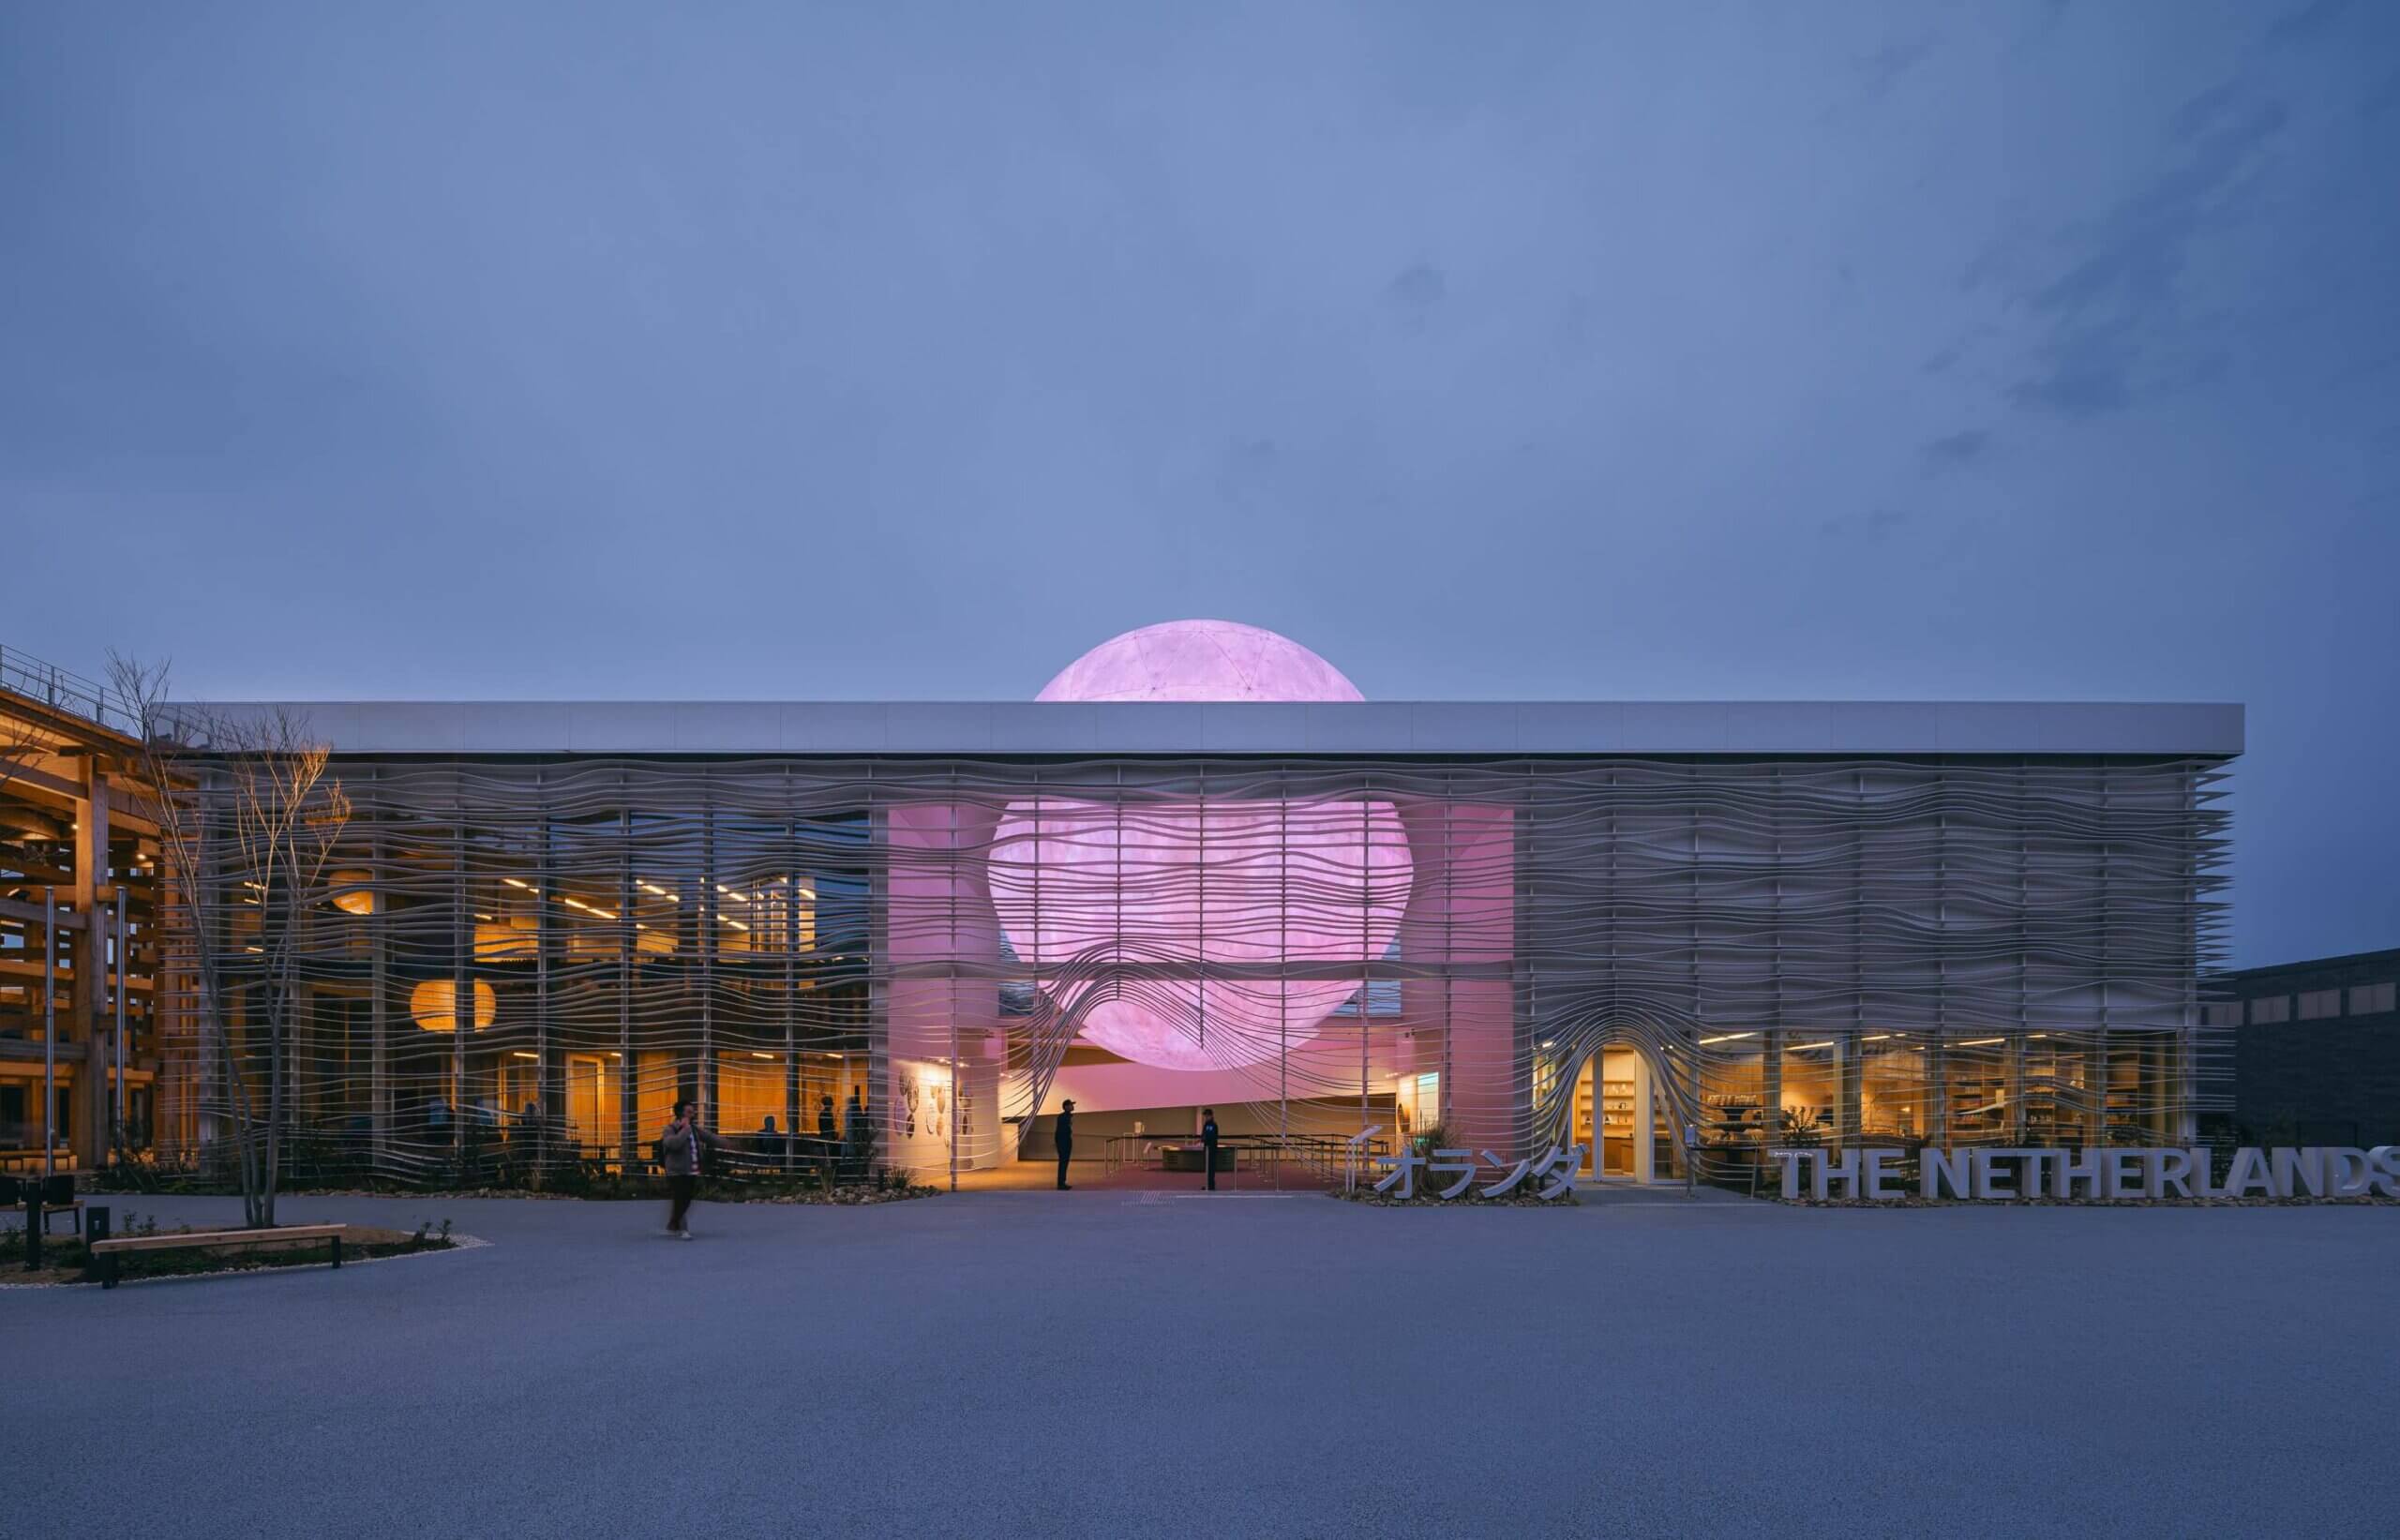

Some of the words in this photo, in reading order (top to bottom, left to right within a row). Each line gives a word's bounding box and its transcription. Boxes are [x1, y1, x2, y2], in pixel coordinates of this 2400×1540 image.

[1372, 1143, 1589, 1200] オランダ
[1767, 1147, 1906, 1199] THE
